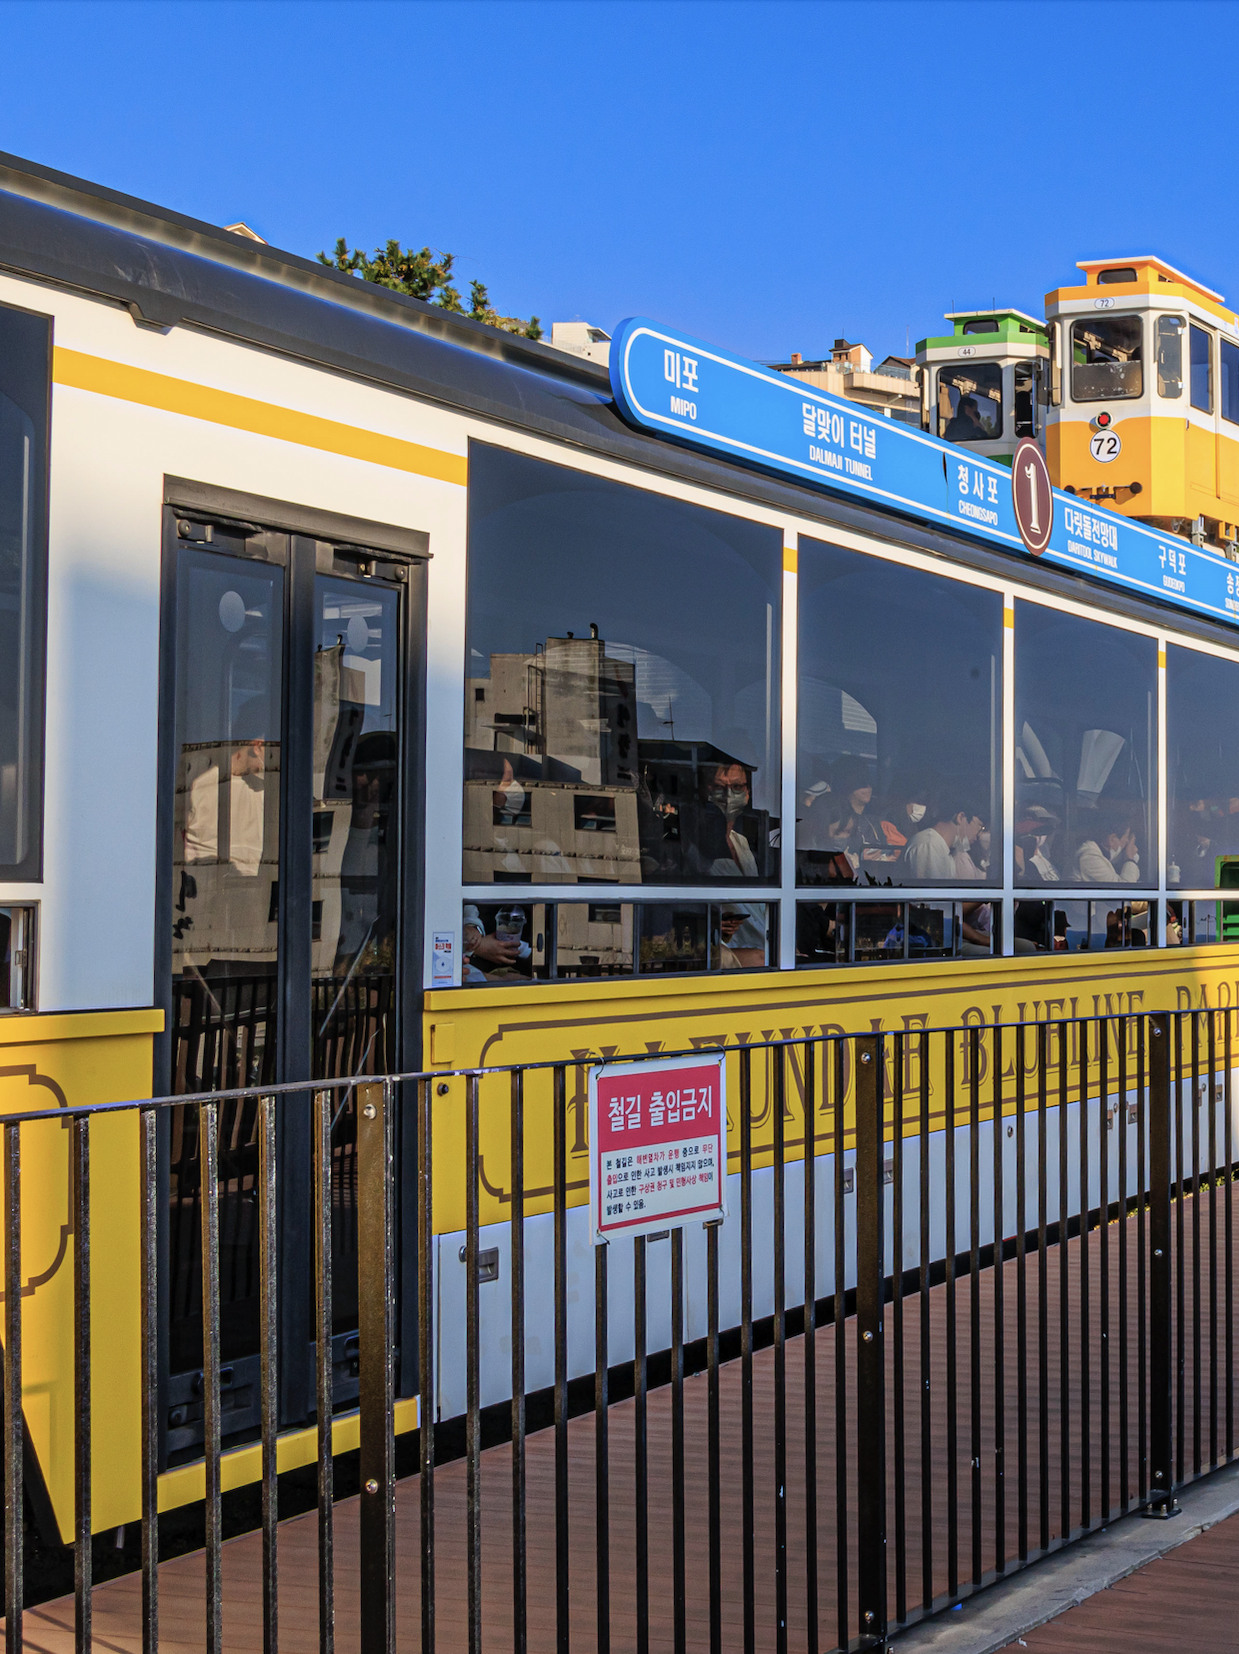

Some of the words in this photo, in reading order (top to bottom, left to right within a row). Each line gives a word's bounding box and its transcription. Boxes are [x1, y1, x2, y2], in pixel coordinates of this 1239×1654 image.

[1099, 299, 1109, 307] 72
[962, 348, 971, 356] 44
[664, 349, 699, 393] 미포
[670, 395, 697, 420] MIPO
[802, 402, 845, 449] 달맞이
[849, 420, 877, 460] 터널
[1093, 437, 1118, 455] 72
[809, 444, 843, 472] DALMAJI
[844, 457, 873, 481] TUNNEL
[957, 464, 999, 504] 청사포
[1024, 462, 1043, 535] 1
[958, 499, 998, 526] CHEONGSAPO
[1064, 506, 1119, 551] 다릿돌전망대
[1158, 544, 1187, 576] 구덕포
[960, 990, 1146, 1086] BLUELINE
[608, 1094, 642, 1132] 철길
[649, 1085, 713, 1127] 출입금지
[606, 1160, 612, 1170] 본
[615, 1156, 633, 1169] 철길은
[667, 1148, 680, 1160] 운행
[682, 1146, 699, 1158] 중으로
[702, 1143, 713, 1154] 무단
[606, 1187, 623, 1200] 사고로
[625, 1185, 637, 1197] 인한
[638, 1182, 655, 1195] 구상권
[656, 1180, 668, 1191] 청구
[669, 1178, 675, 1189] 및
[675, 1174, 697, 1188] 민형사상
[607, 1173, 629, 1186] 출입으로
[630, 1170, 642, 1180] 인한
[644, 1168, 655, 1178] 사고
[657, 1164, 673, 1177] 발생시
[675, 1160, 696, 1173] 책임지지
[606, 1203, 624, 1216] 발생할
[625, 1201, 632, 1212] 수
[633, 1198, 646, 1211] 있음.
